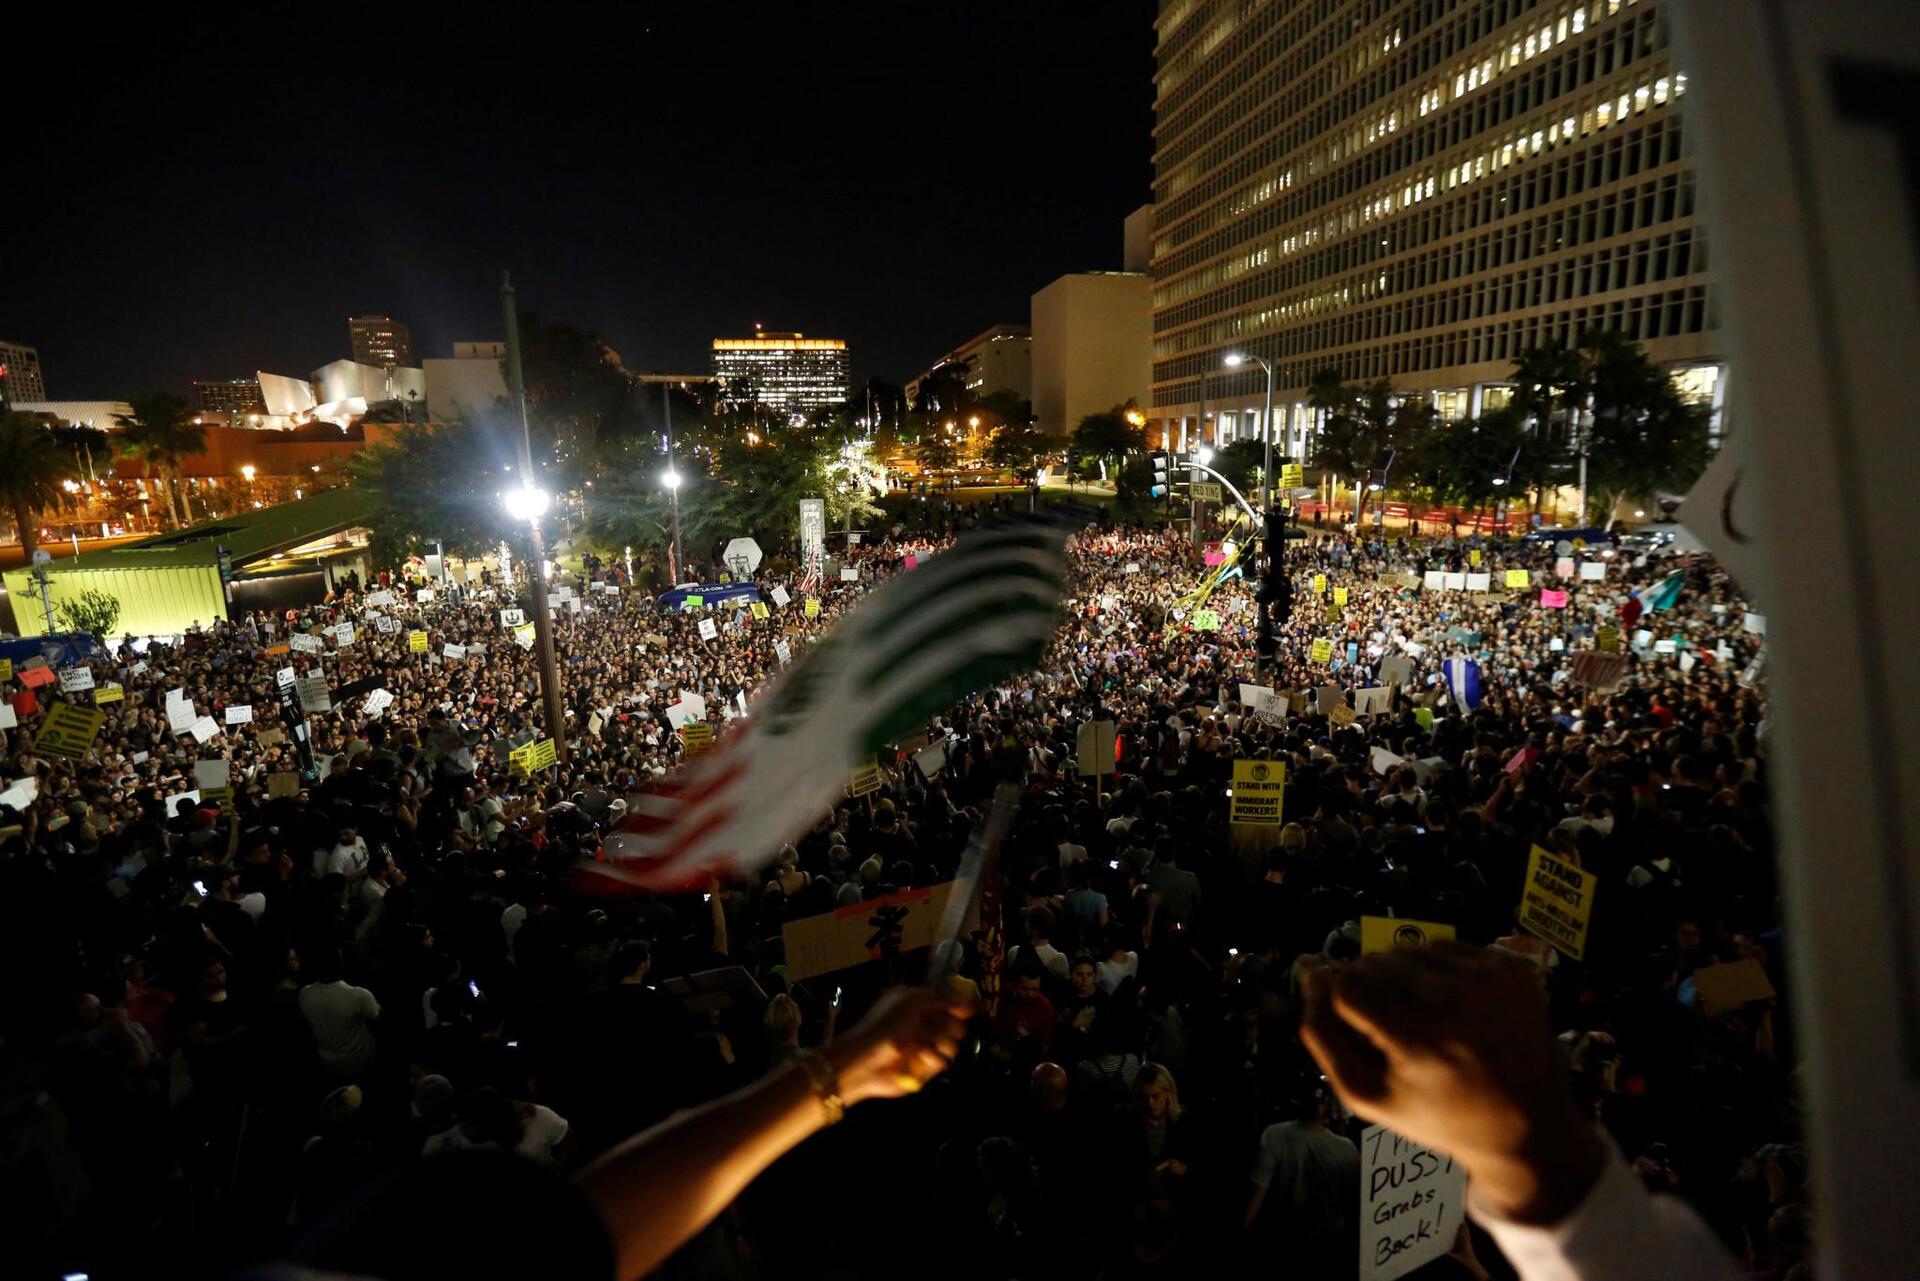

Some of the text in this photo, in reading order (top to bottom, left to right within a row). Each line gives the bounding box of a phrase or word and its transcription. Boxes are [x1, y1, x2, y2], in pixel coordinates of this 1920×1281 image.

[1192, 485, 1219, 498] PED XING
[1264, 694, 1280, 705] NOT
[1237, 781, 1280, 791] STAND WITH
[1236, 796, 1279, 805] IMMIGRANT
[1235, 805, 1278, 815] WORKERS!
[1538, 854, 1583, 888] STAND
[1533, 869, 1584, 908] AGAINST
[1373, 1188, 1436, 1225] Grabs
[1375, 1202, 1444, 1267] Back!
